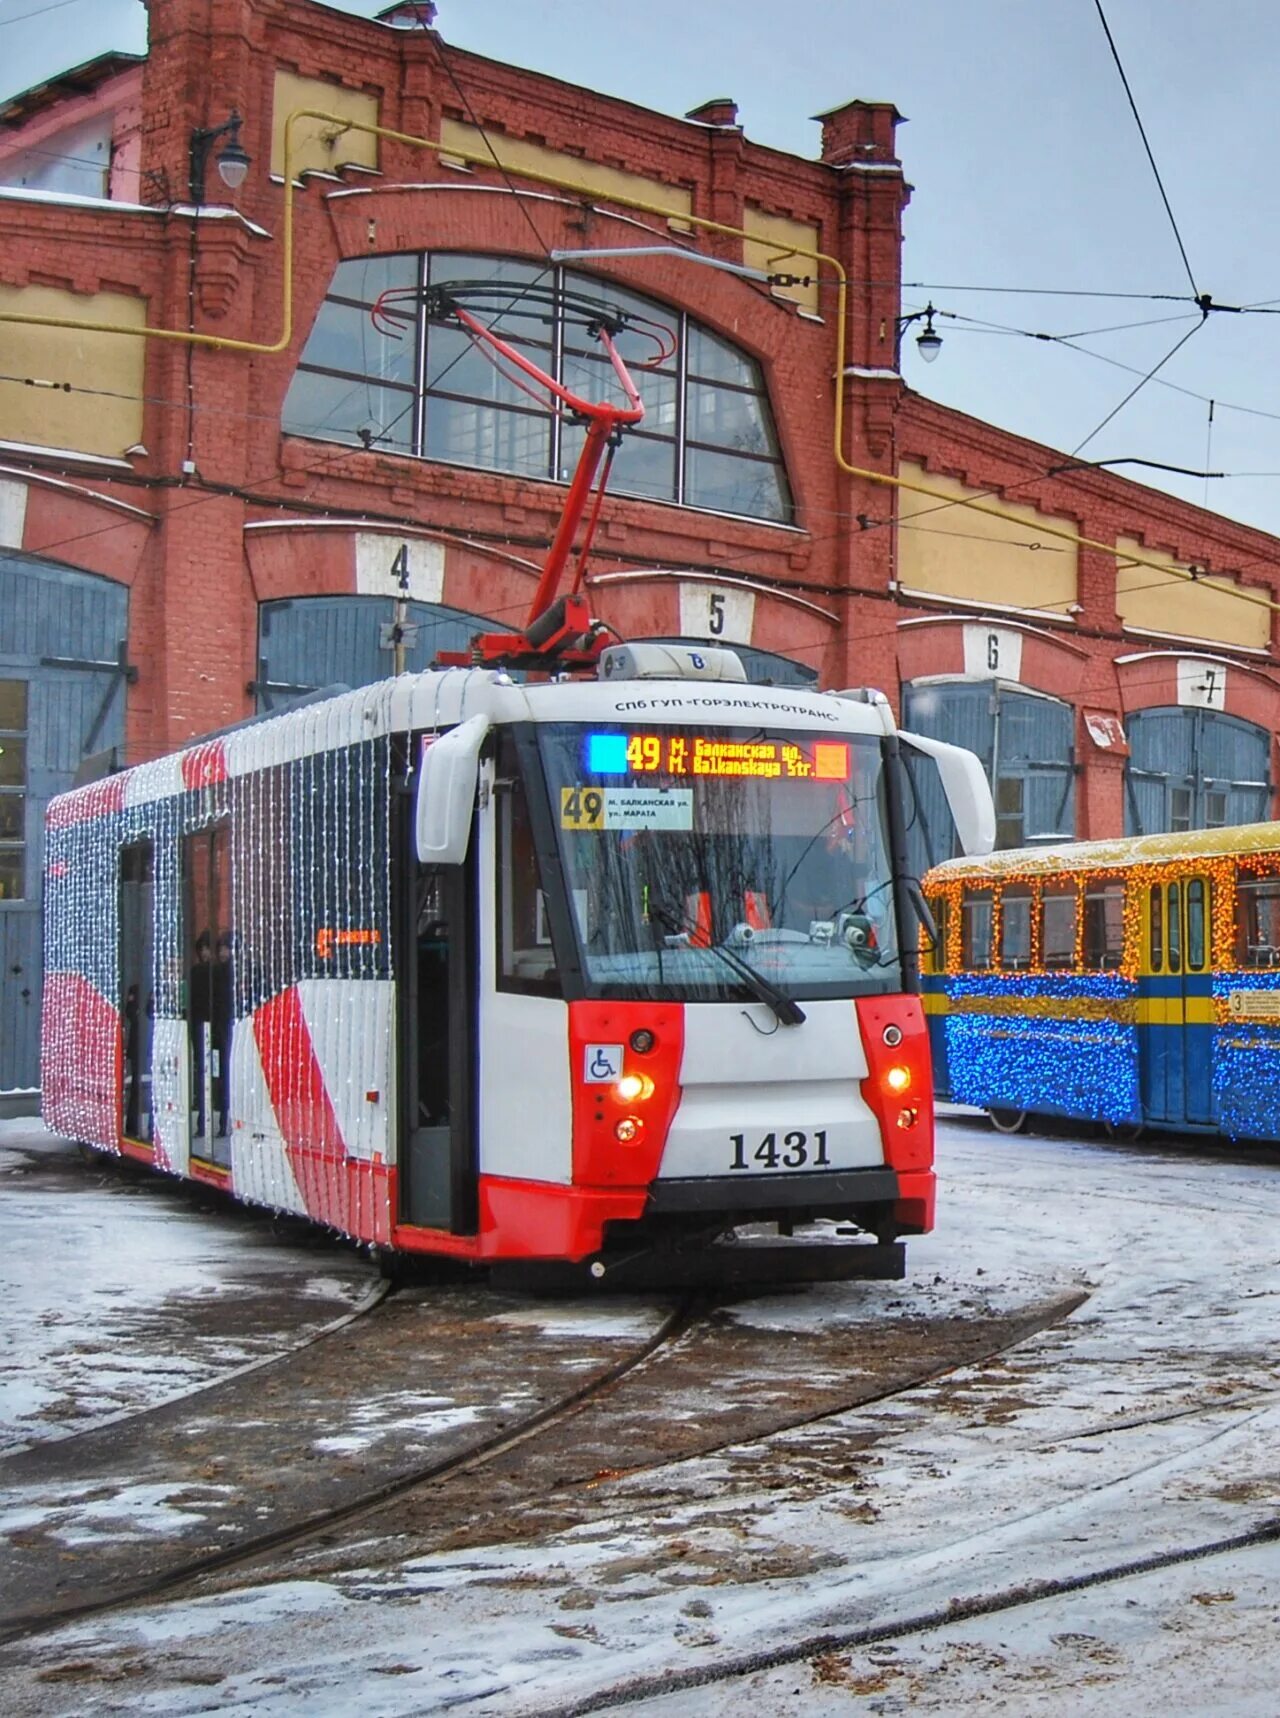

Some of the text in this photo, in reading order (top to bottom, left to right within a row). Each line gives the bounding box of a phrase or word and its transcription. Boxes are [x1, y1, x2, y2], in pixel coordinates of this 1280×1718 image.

[391, 543, 410, 590] 4
[709, 593, 725, 635] 5
[987, 634, 999, 671] 6
[1205, 670, 1216, 704] 7
[615, 698, 840, 722] СПб ГУП «ГОРЭЛЕКТРОТРАНС»
[626, 736, 661, 770] 49
[693, 756, 782, 777] Balkanskaya
[786, 758, 816, 777] Str.
[694, 740, 776, 759] Балканская
[781, 746, 802, 762] ул.
[562, 791, 603, 824] 49
[621, 799, 675, 807] БАЛКАНСКАЯ
[1234, 994, 1242, 1012] 3
[729, 1130, 831, 1170] 1431
